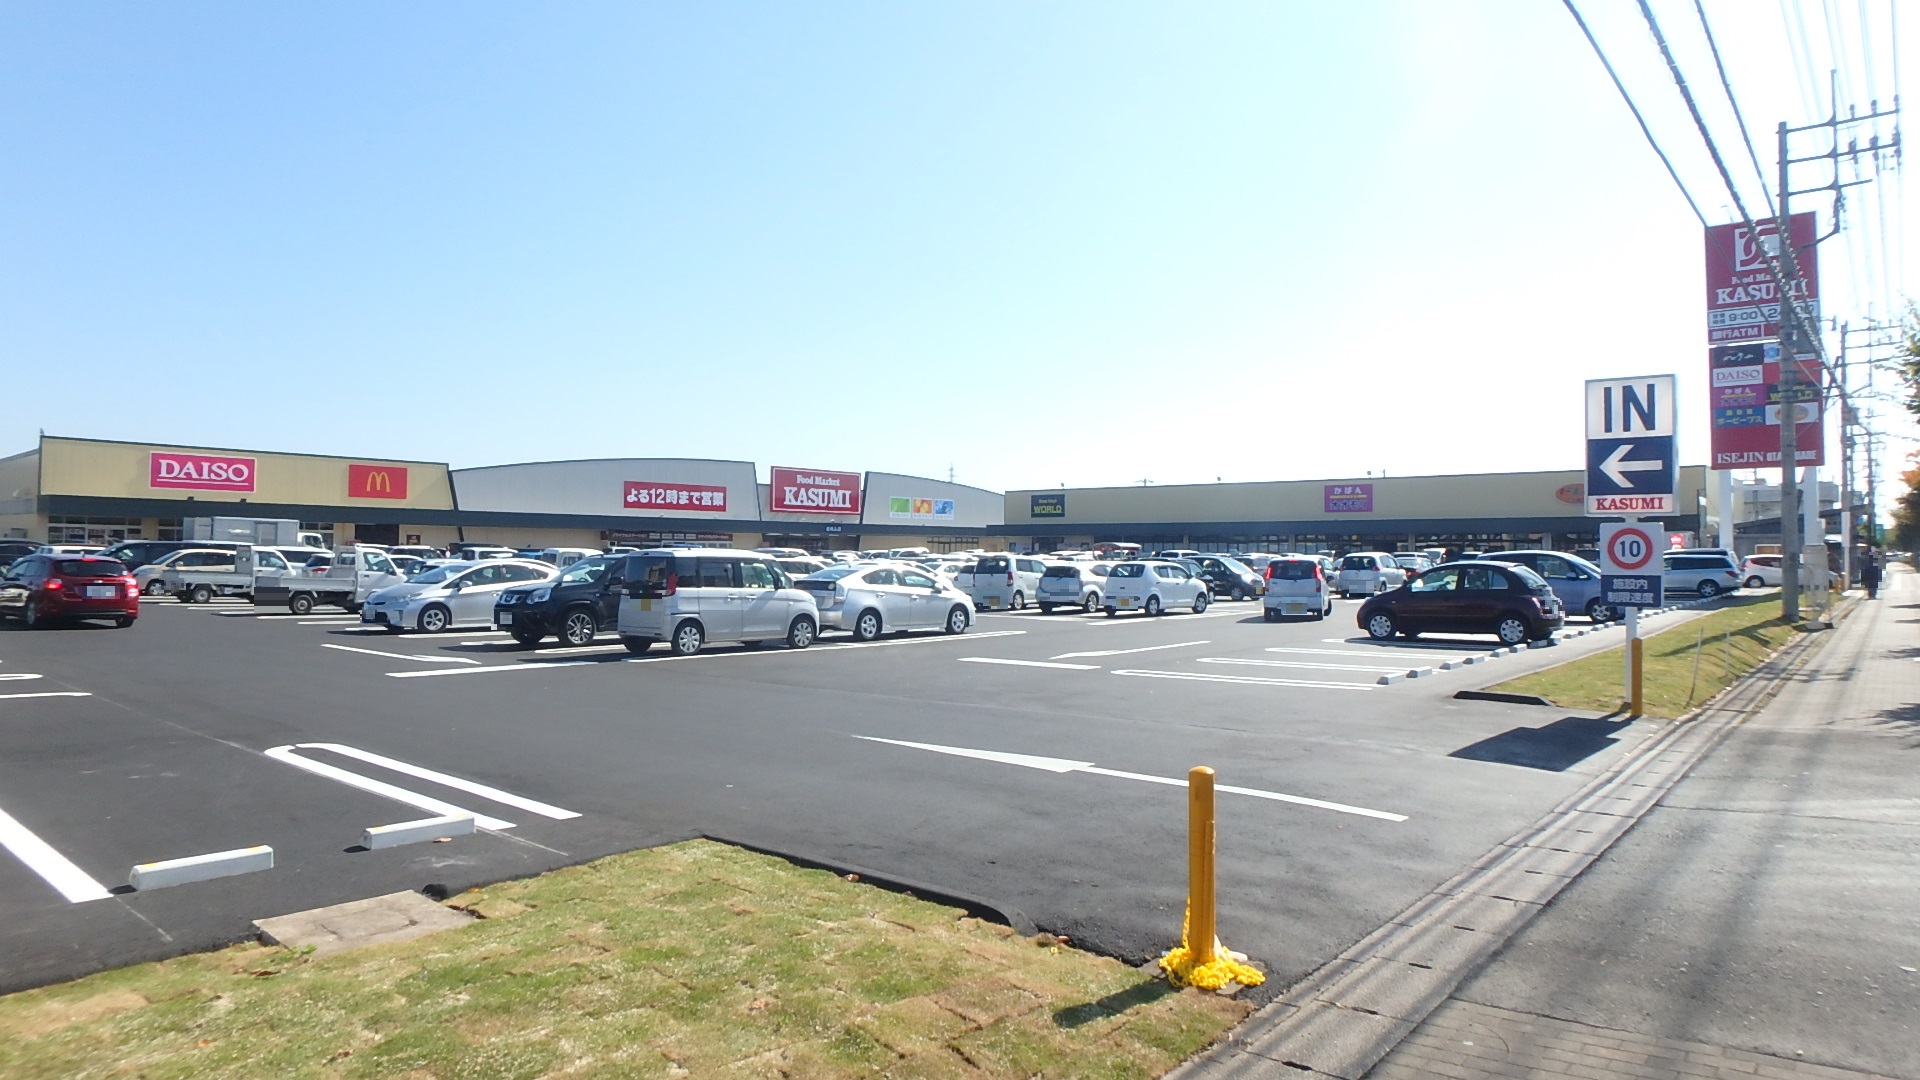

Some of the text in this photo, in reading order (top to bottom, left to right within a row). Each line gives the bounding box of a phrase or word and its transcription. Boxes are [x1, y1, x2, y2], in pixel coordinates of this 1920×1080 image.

[1716, 369, 1760, 381] DAISO
[1604, 383, 1656, 433] IN
[1717, 451, 1764, 464] ISEJIN
[158, 459, 249, 482] DAISO
[796, 474, 841, 487] Food Market
[783, 486, 852, 508] KASUMI
[1595, 497, 1664, 511] KASUMI
[1034, 505, 1062, 513] WORLD
[1619, 540, 1641, 558] 10
